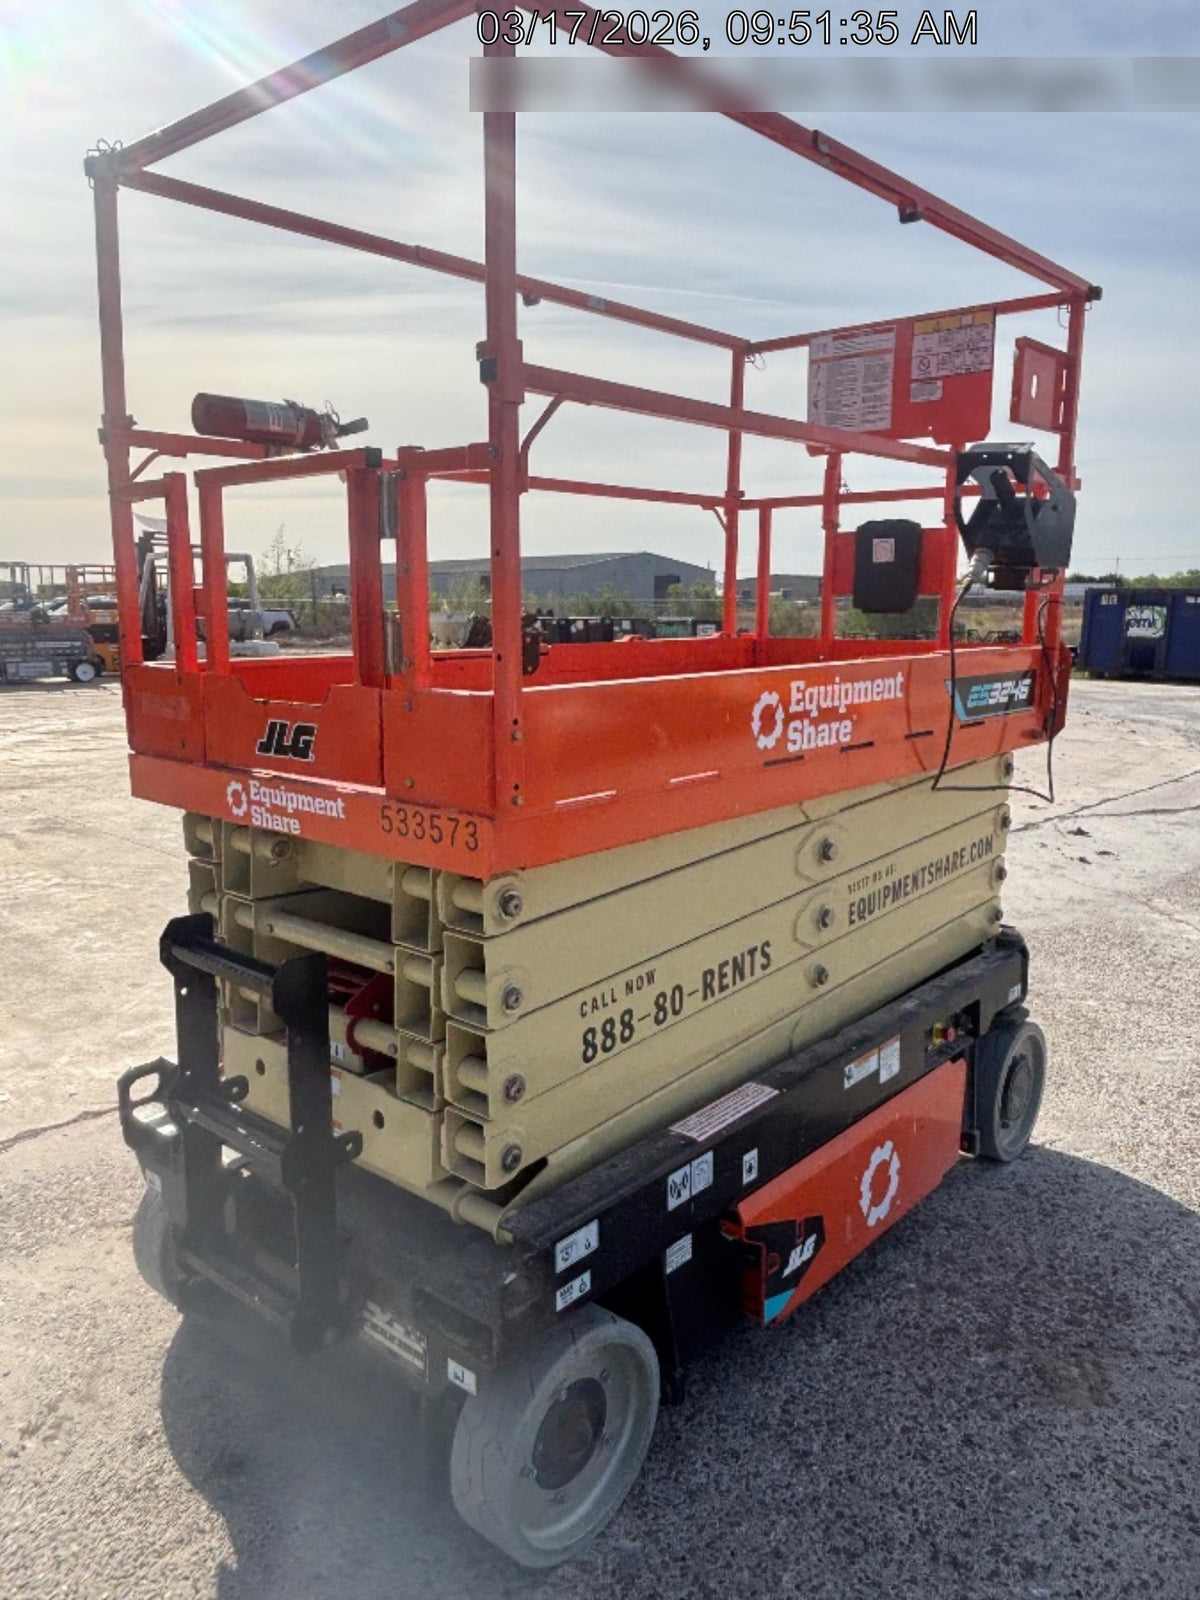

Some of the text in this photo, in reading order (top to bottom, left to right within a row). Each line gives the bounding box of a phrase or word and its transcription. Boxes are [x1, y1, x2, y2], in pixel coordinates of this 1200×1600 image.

[789, 672, 904, 716] Equipment
[255, 719, 317, 762] JLG
[787, 719, 853, 752] Share
[249, 780, 345, 819] Equipment
[251, 805, 300, 834] Share
[381, 805, 479, 851] 533573
[848, 836, 994, 927] EQUIPMENTSHARE.COM
[580, 968, 657, 1018] CALL NOW
[582, 940, 772, 1064] 888-80-RENTS
